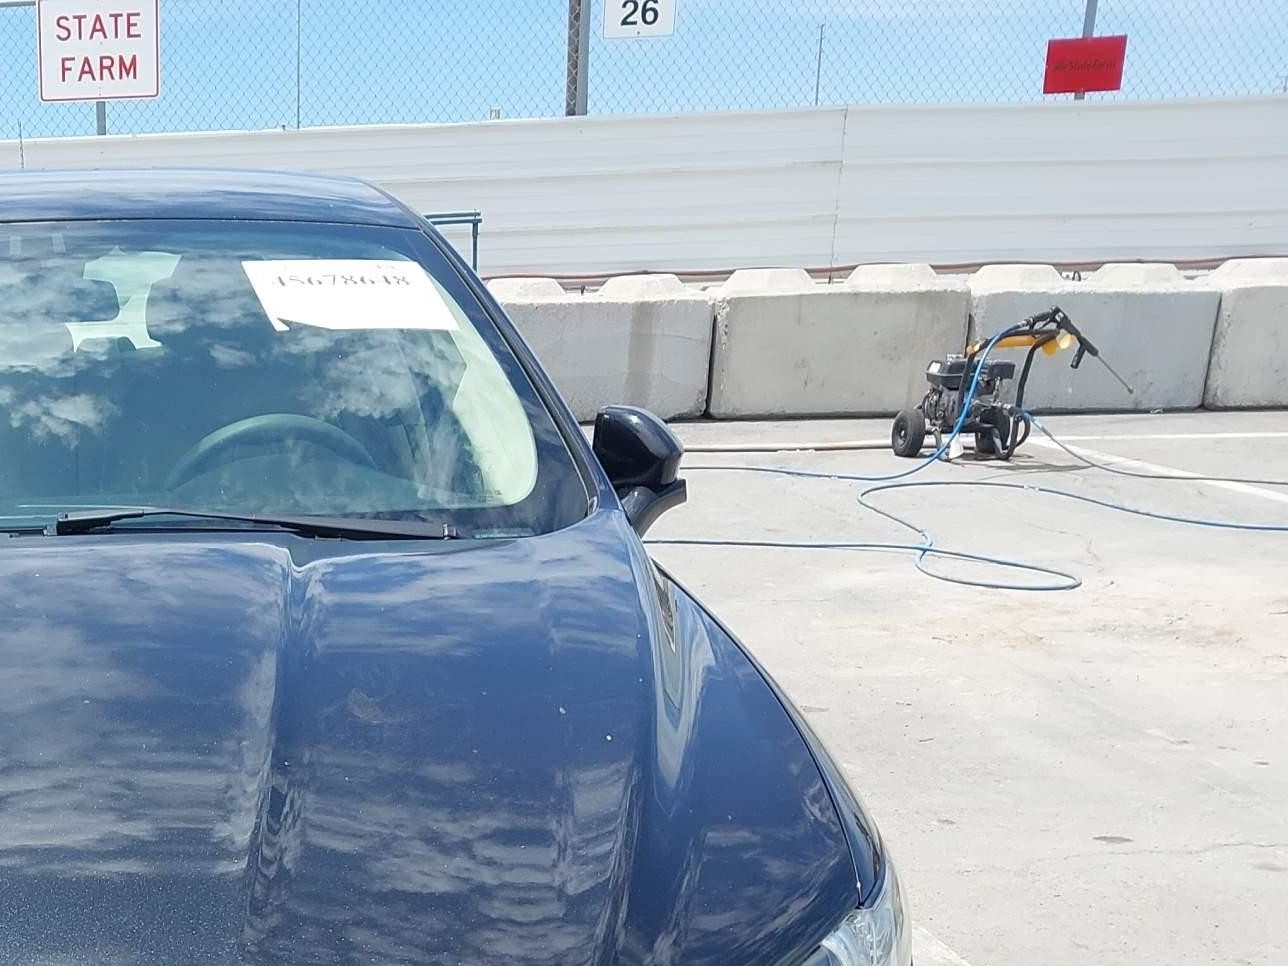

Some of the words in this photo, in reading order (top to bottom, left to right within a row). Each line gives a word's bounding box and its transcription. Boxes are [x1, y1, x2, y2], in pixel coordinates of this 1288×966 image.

[55, 12, 142, 42] STATE
[620, 0, 659, 26] 26
[60, 54, 137, 82] FARM
